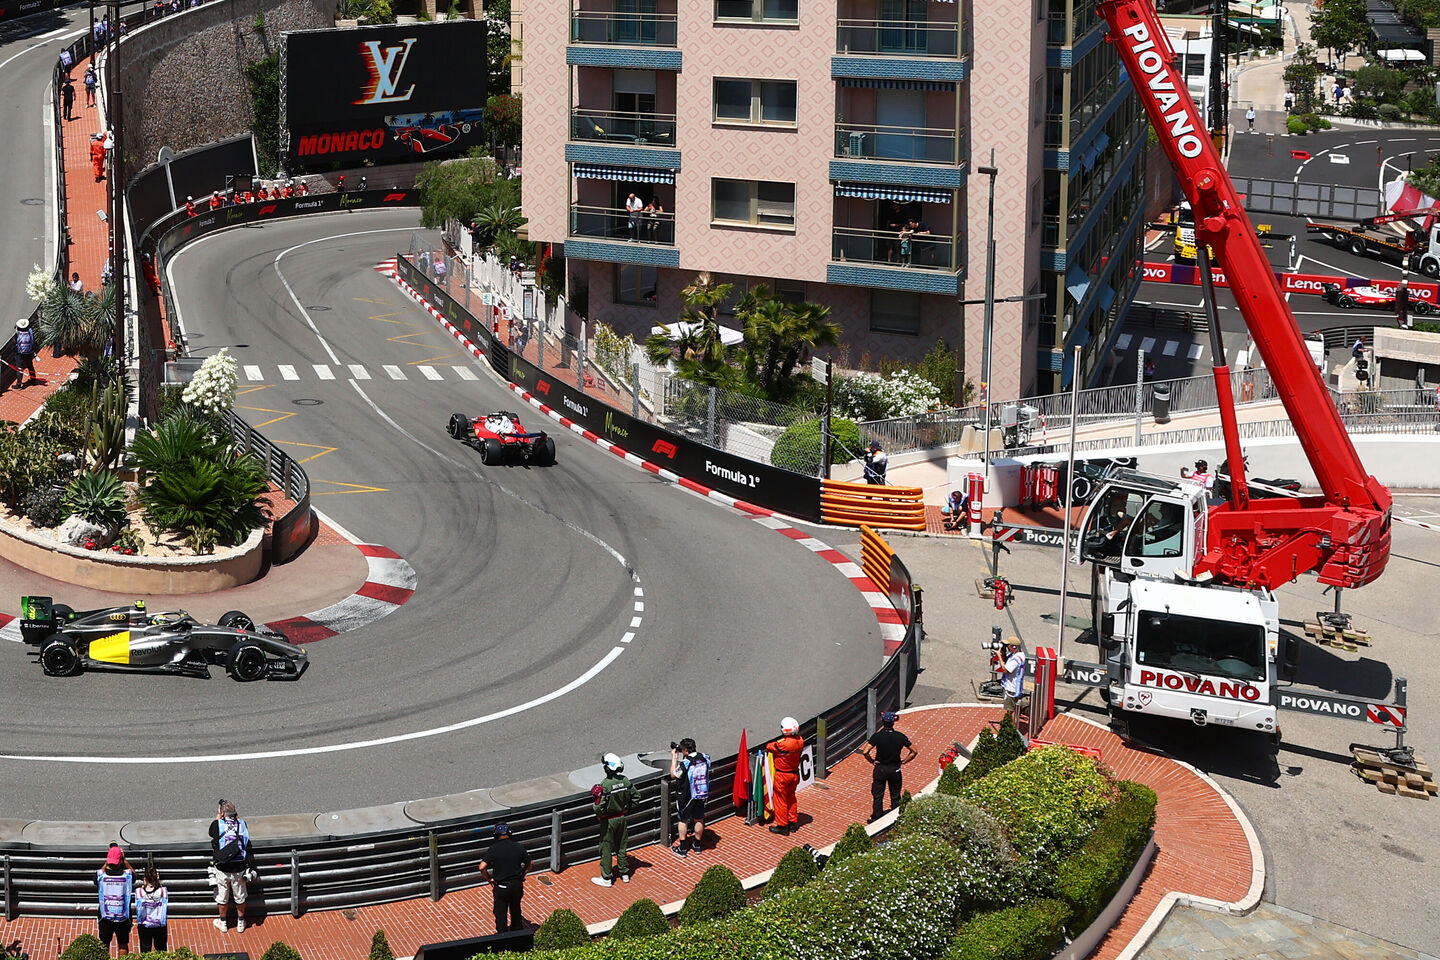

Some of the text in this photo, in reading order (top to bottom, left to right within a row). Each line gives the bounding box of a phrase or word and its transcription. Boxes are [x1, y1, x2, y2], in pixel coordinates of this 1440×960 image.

[1123, 22, 1203, 158] PIOVANO
[298, 128, 385, 156] MONACO
[1143, 268, 1166, 278] ovo
[563, 395, 581, 414] Formula
[705, 460, 747, 486] Formula
[131, 645, 164, 657] Revolut
[1028, 660, 1102, 683] PANO
[1140, 670, 1261, 701] PIOVANO
[1280, 695, 1361, 717] PIOVANO
[800, 753, 811, 782] C
